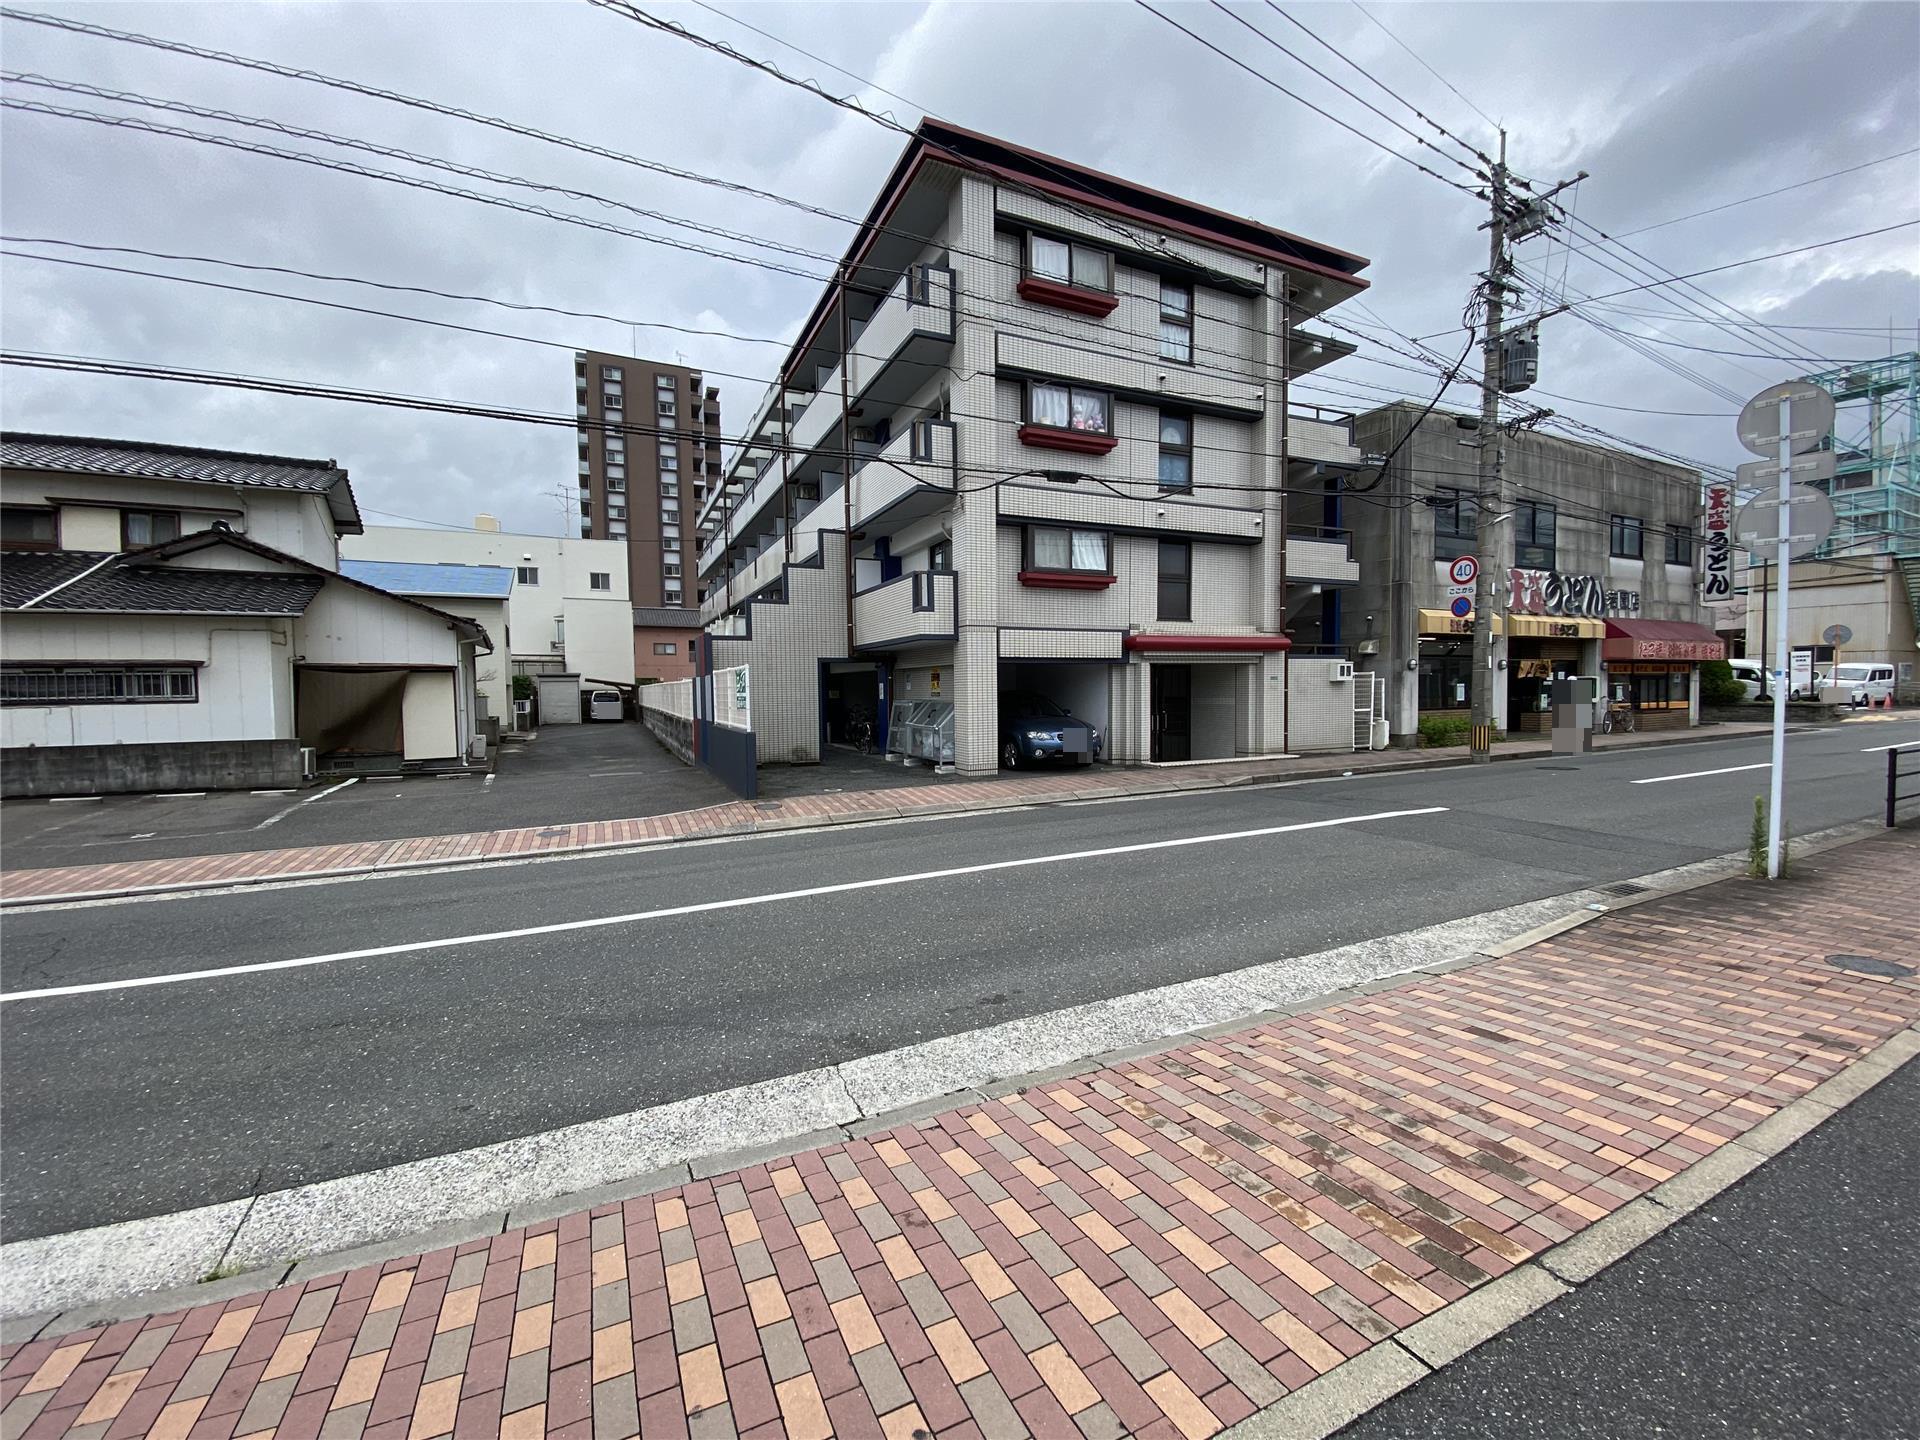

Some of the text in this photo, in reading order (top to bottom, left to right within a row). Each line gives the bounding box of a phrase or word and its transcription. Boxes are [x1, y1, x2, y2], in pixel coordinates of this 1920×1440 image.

[1706, 488, 1730, 595] 天盛うどん
[1456, 564, 1472, 577] 40
[1449, 587, 1474, 595] ここから
